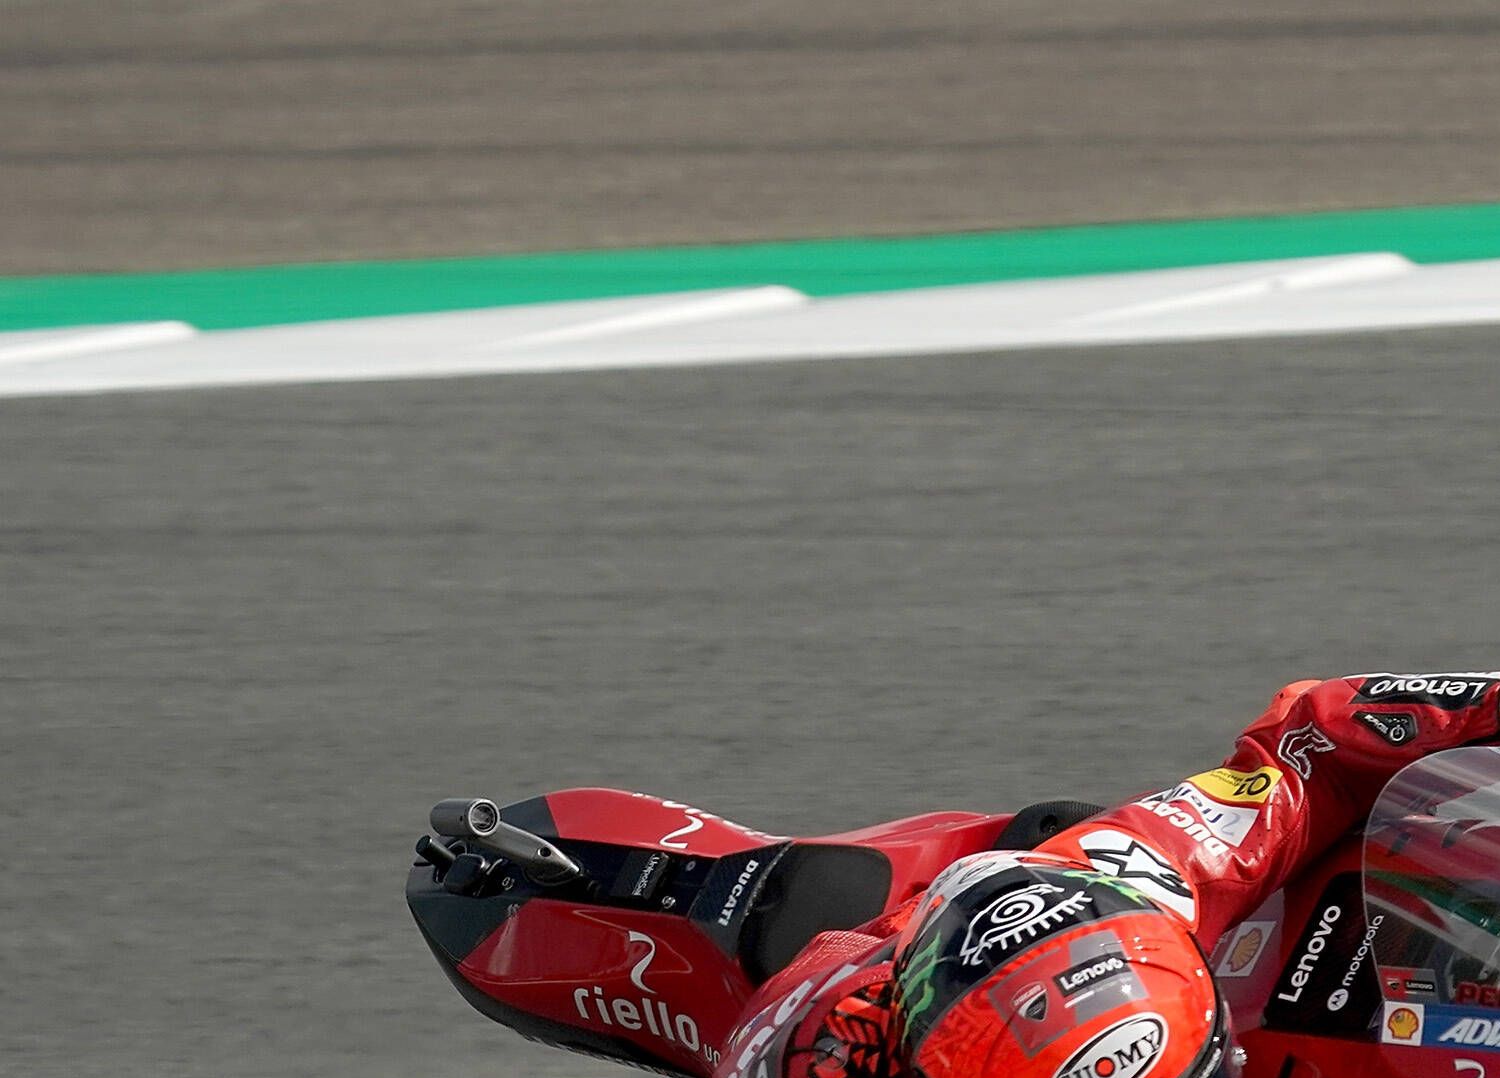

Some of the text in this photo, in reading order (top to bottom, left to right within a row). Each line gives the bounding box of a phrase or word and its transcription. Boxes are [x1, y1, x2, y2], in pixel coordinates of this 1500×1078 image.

[1371, 678, 1487, 699] Lenovo
[1132, 796, 1230, 856] DUCAT
[717, 859, 758, 928] DUCATI
[1059, 957, 1124, 991] Lenovo
[1278, 905, 1341, 1004] Lenovo
[1342, 915, 1385, 988] motorola
[573, 983, 700, 1051] riello
